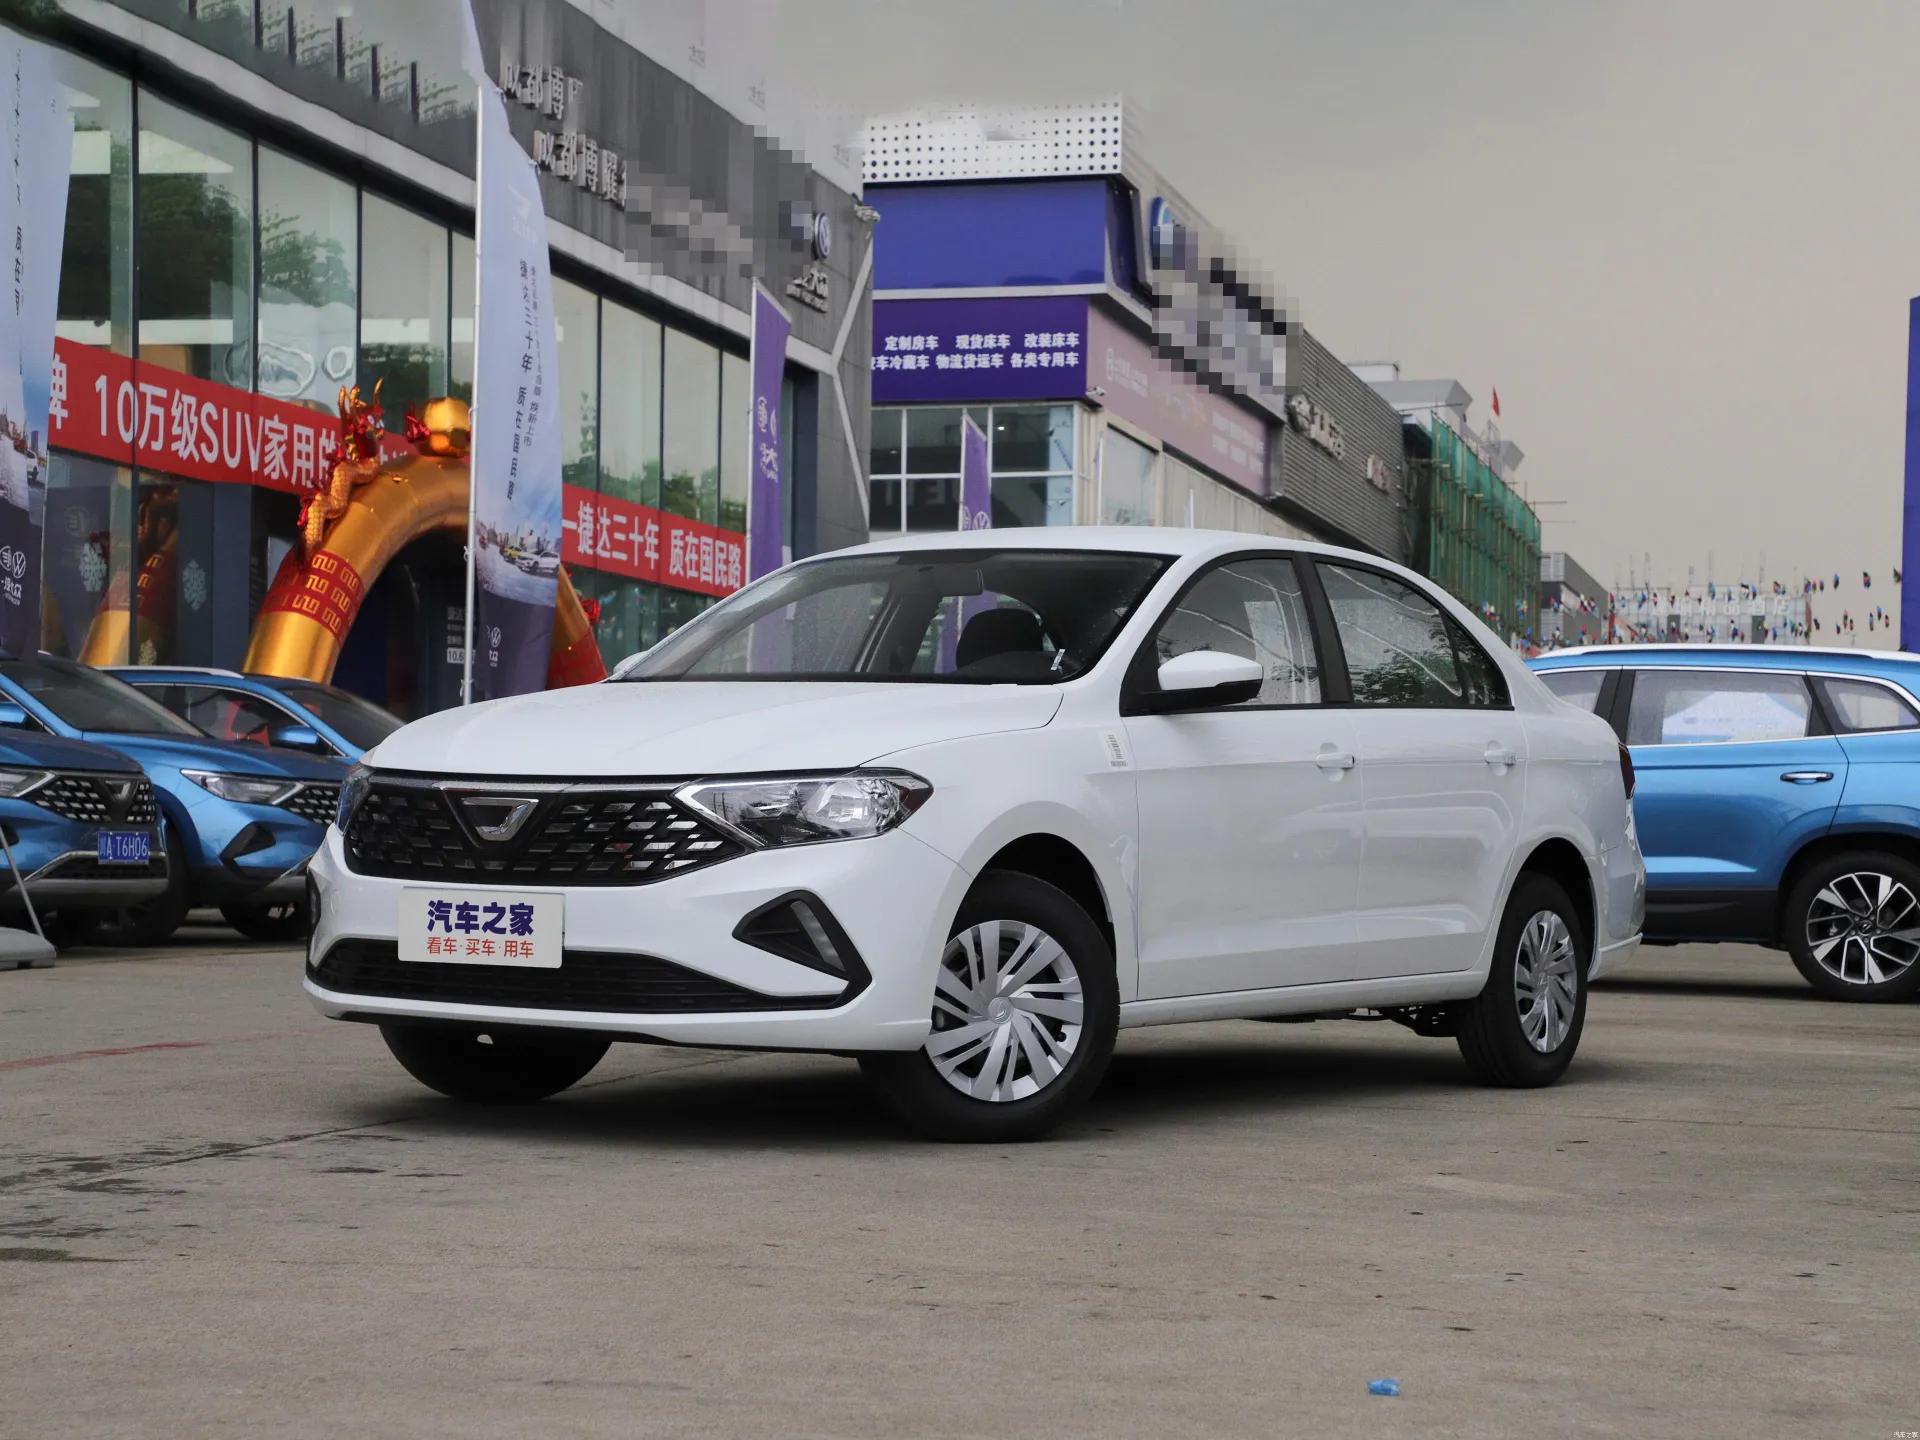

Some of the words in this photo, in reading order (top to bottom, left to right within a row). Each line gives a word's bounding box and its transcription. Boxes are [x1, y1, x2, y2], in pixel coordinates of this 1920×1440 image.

[885, 335, 939, 351] 定制房车
[955, 334, 1011, 350] 现货床车
[1024, 332, 1080, 348] 改装床车
[935, 353, 1004, 369] 物流货运车
[1010, 352, 1080, 368] 各类专用车
[669, 529, 742, 590] 质在国民路
[427, 900, 534, 936] 汽车之家
[427, 937, 534, 959] 看车·买车·用车
